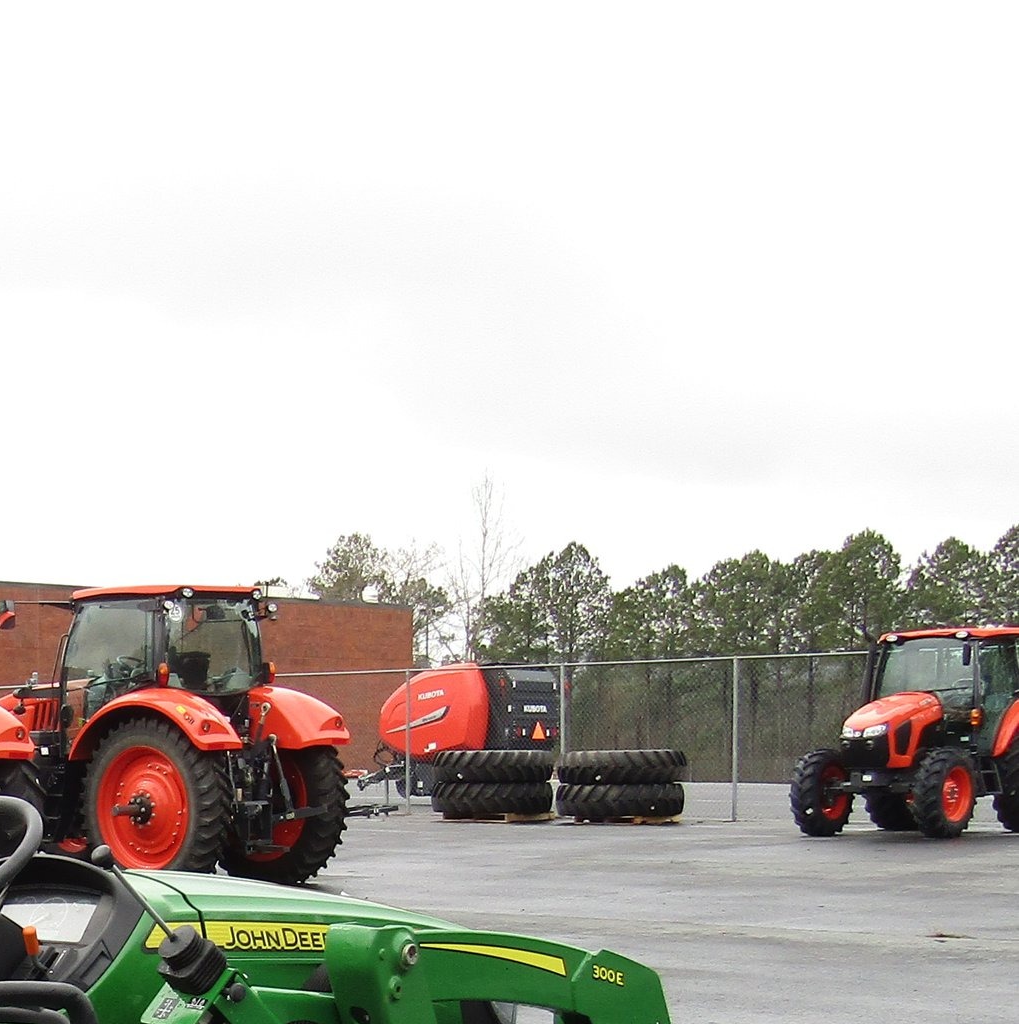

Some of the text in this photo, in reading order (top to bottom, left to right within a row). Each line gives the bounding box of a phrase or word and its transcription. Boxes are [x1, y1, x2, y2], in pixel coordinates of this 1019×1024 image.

[417, 689, 445, 701] KUBOTA
[523, 705, 548, 713] KUBOTA
[225, 926, 326, 949] JOHN DEE
